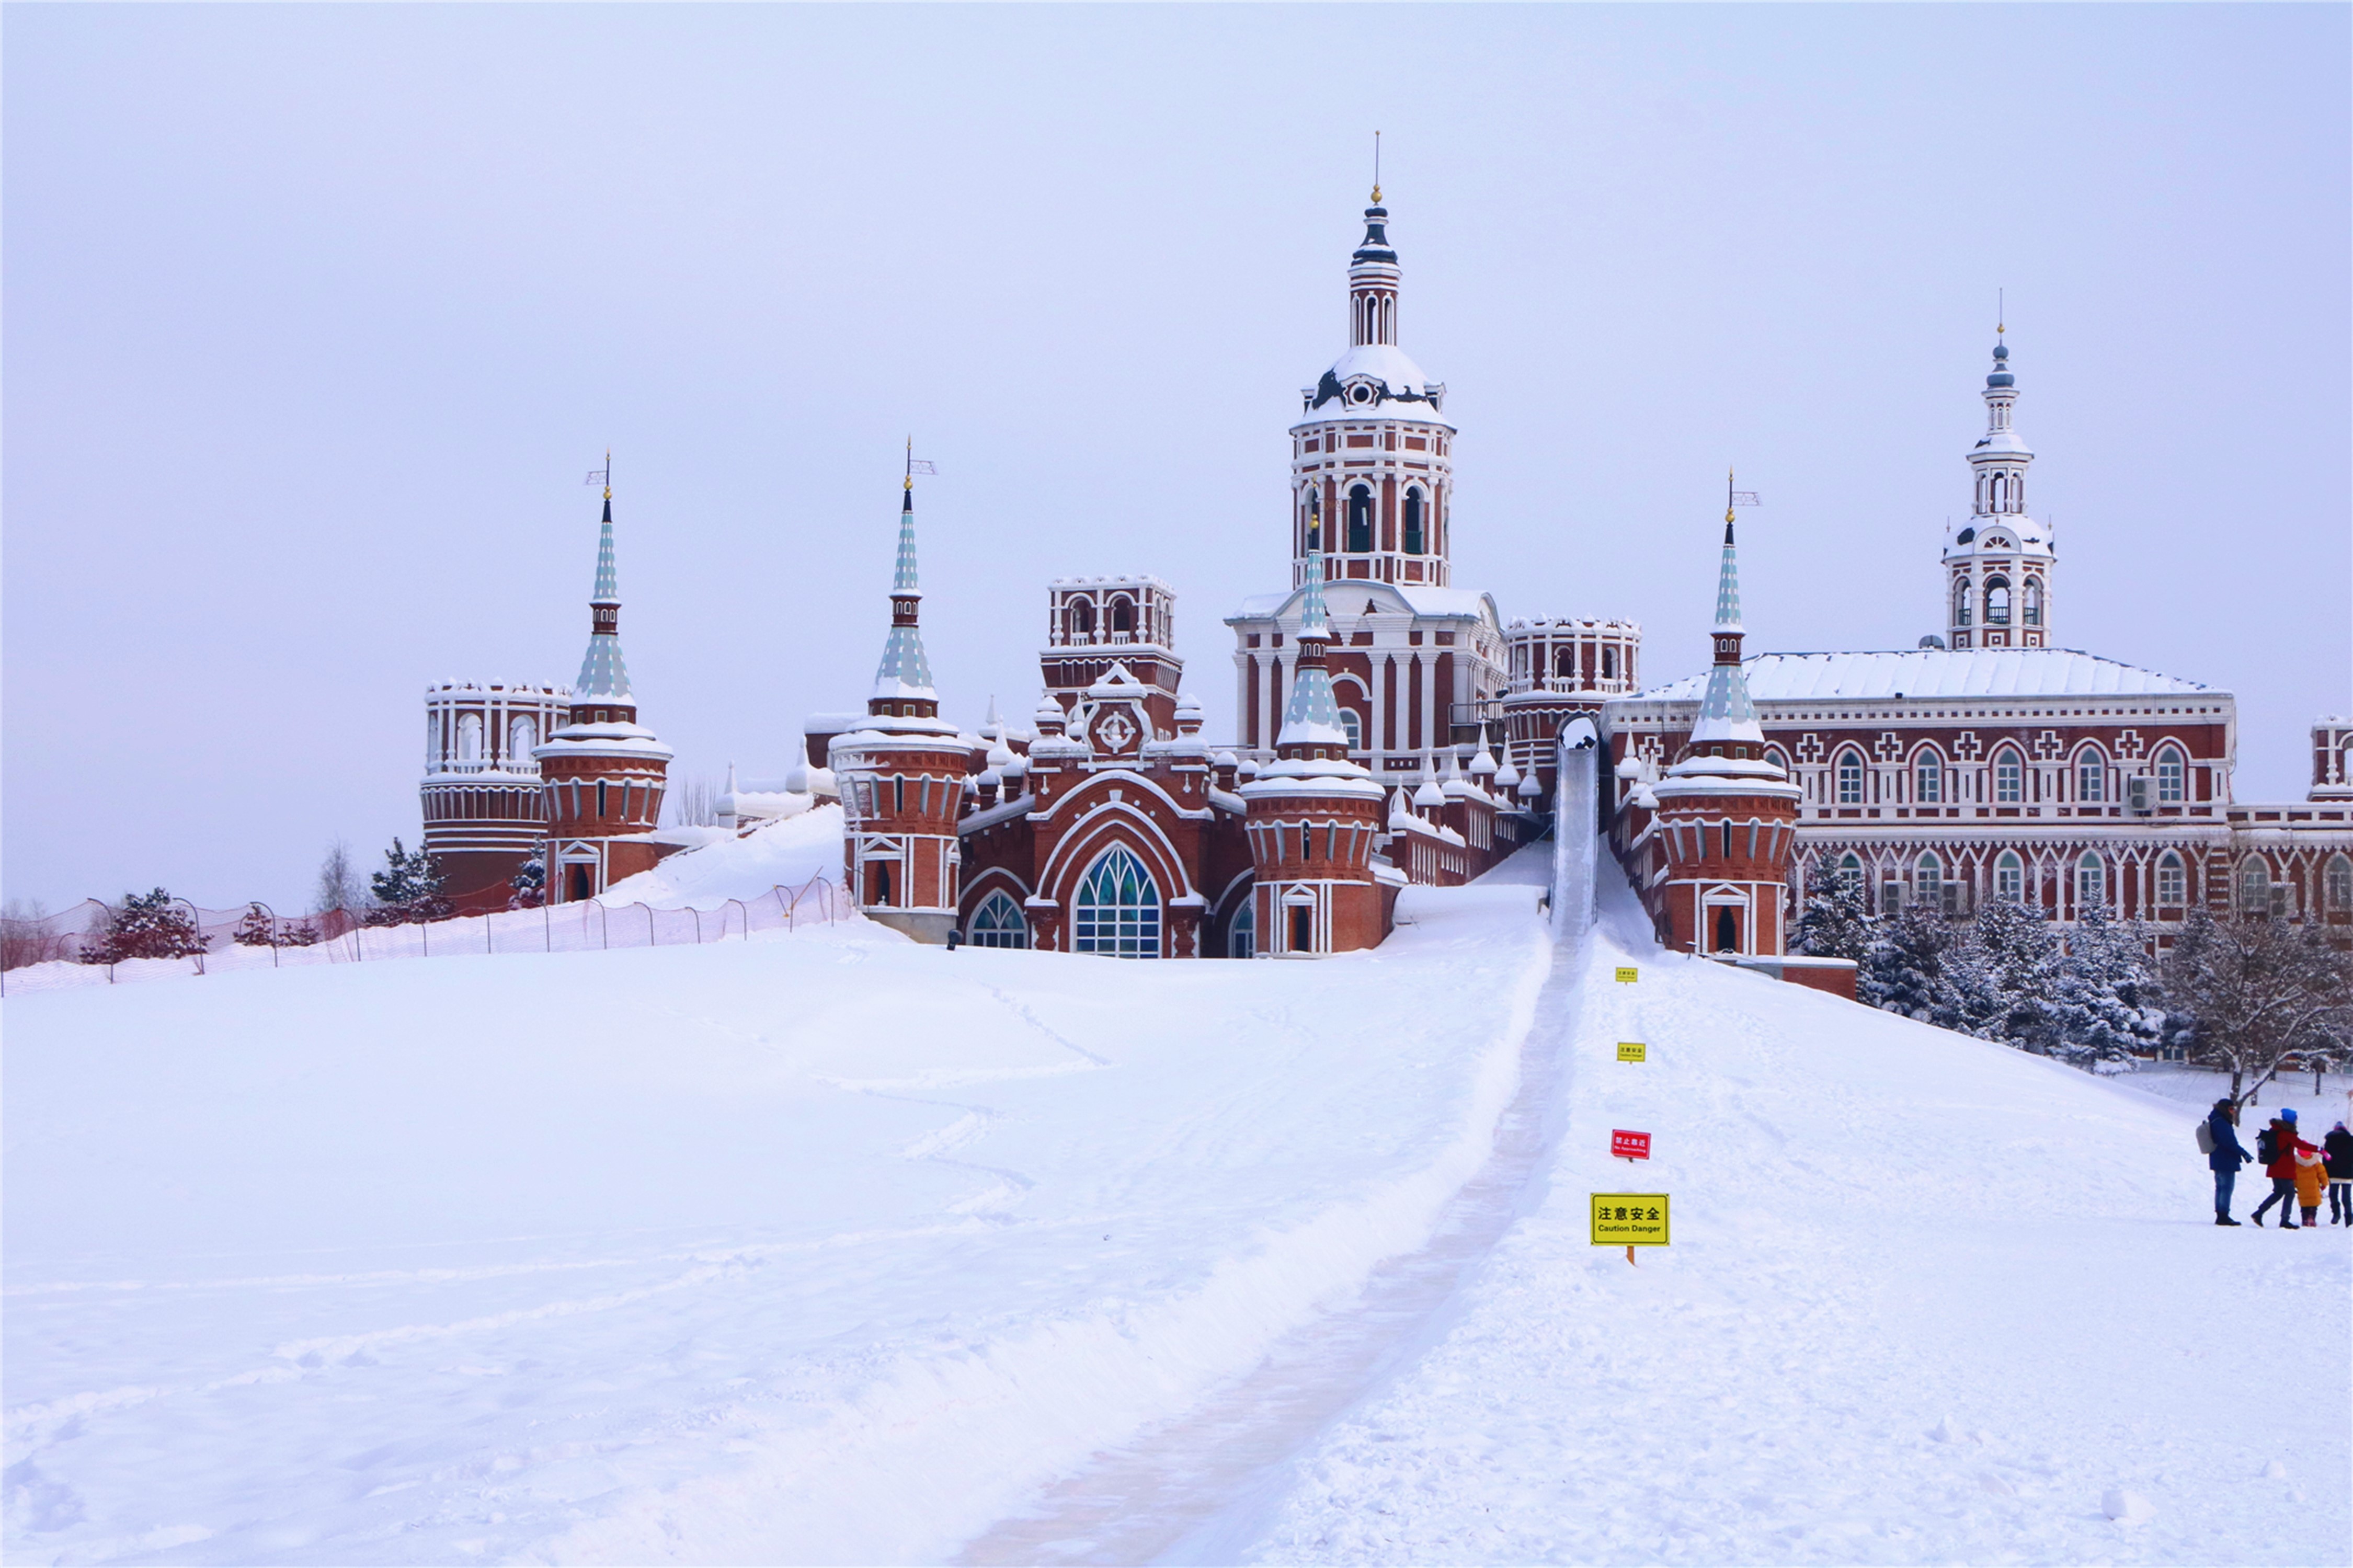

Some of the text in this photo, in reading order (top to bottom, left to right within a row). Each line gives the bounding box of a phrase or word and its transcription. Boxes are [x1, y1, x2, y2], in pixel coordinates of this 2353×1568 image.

[1615, 1136, 1646, 1147] 禁止靠近
[1598, 1206, 1660, 1220] 注意安全
[1631, 1225, 1661, 1233] Danger
